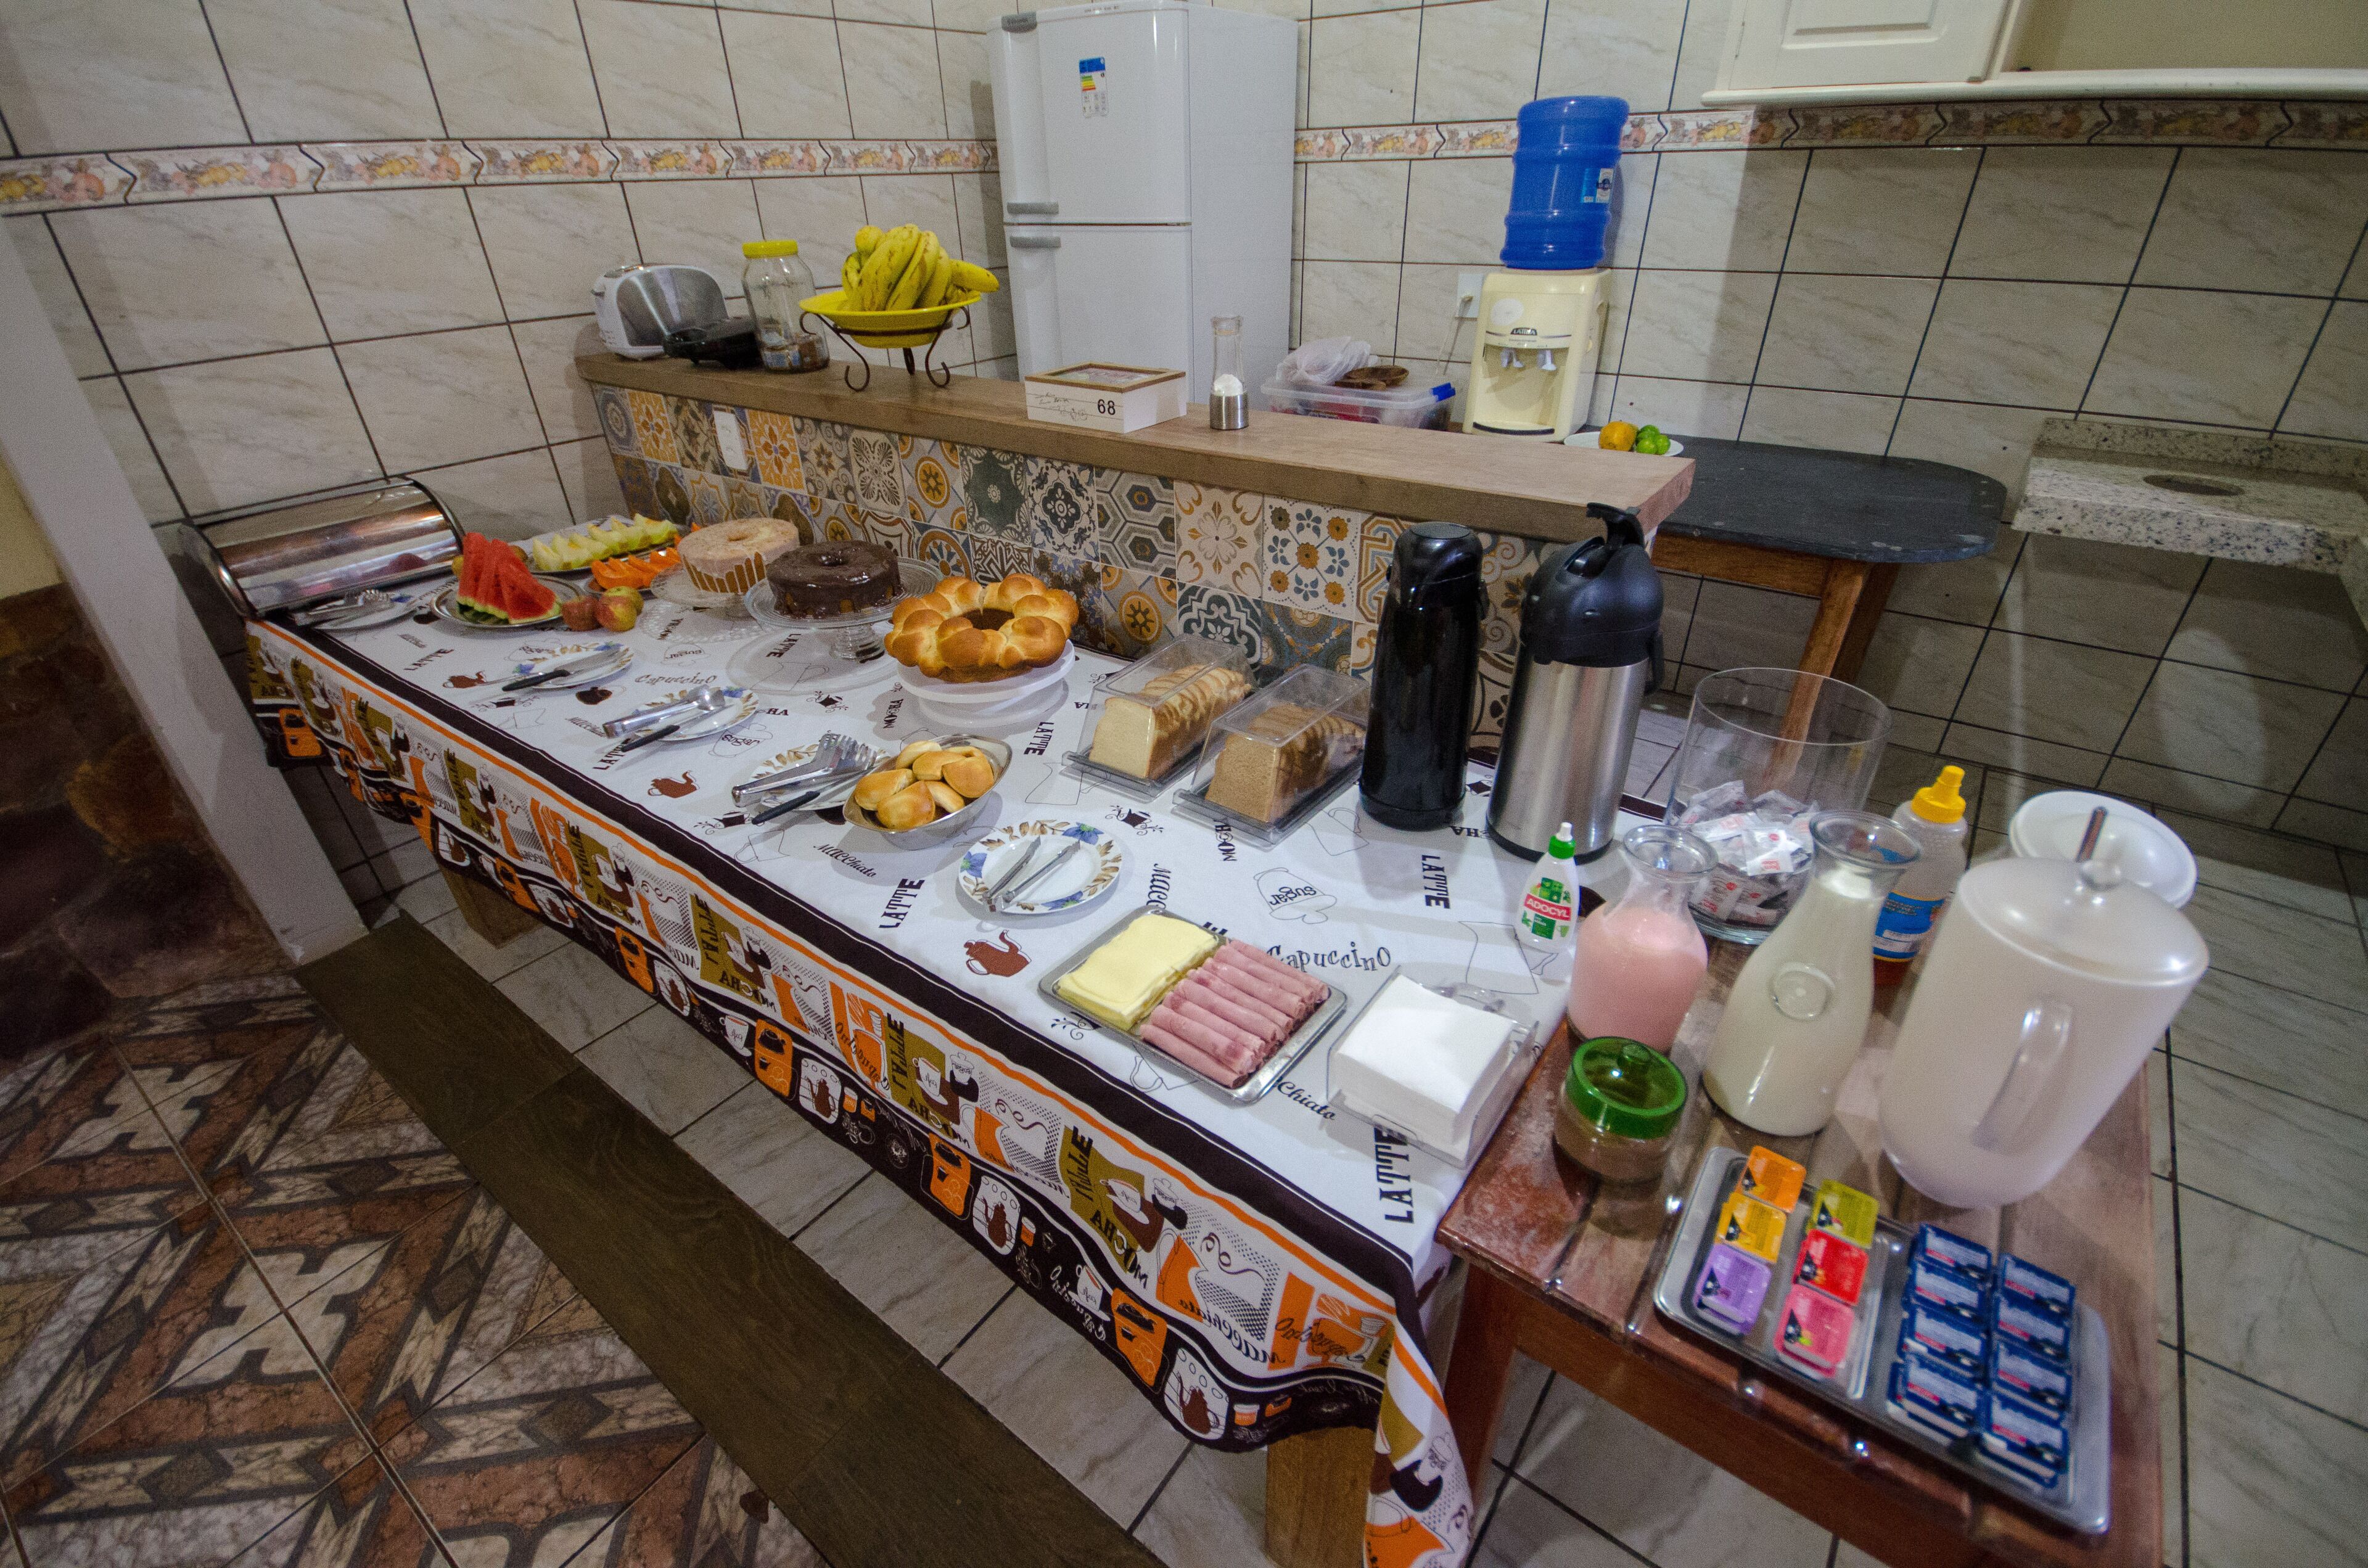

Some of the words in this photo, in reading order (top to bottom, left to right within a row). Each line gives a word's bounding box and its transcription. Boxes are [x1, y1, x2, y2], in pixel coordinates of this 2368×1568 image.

[1098, 399, 1116, 415] 68
[1024, 721, 1054, 755] LATTE
[1421, 855, 1450, 909] LATTE
[878, 879, 925, 929] LATTE
[1269, 886, 1317, 906] sugar
[1527, 898, 1569, 918] ADOCYL
